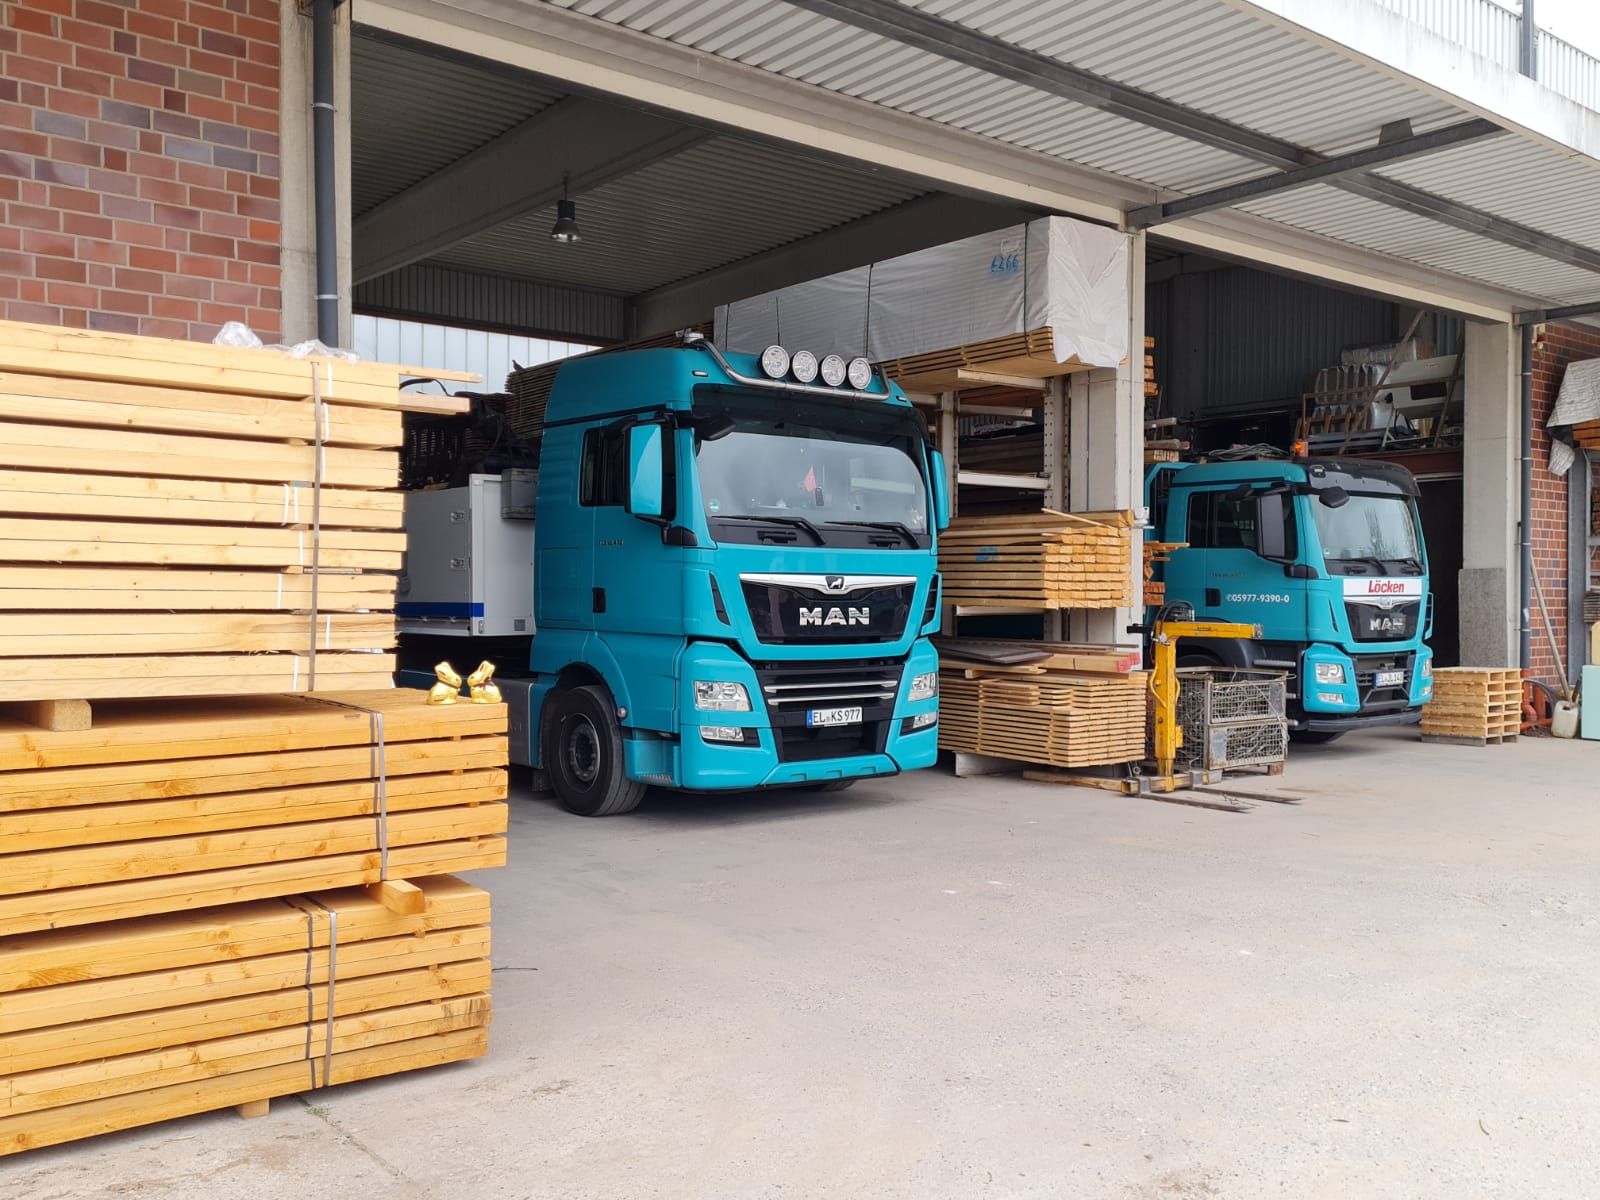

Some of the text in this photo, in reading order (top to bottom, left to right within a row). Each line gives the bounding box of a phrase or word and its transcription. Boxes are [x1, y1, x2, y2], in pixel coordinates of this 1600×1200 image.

[1368, 580, 1405, 593] Löcken
[799, 607, 870, 626] MAN
[813, 711, 826, 723] EL
